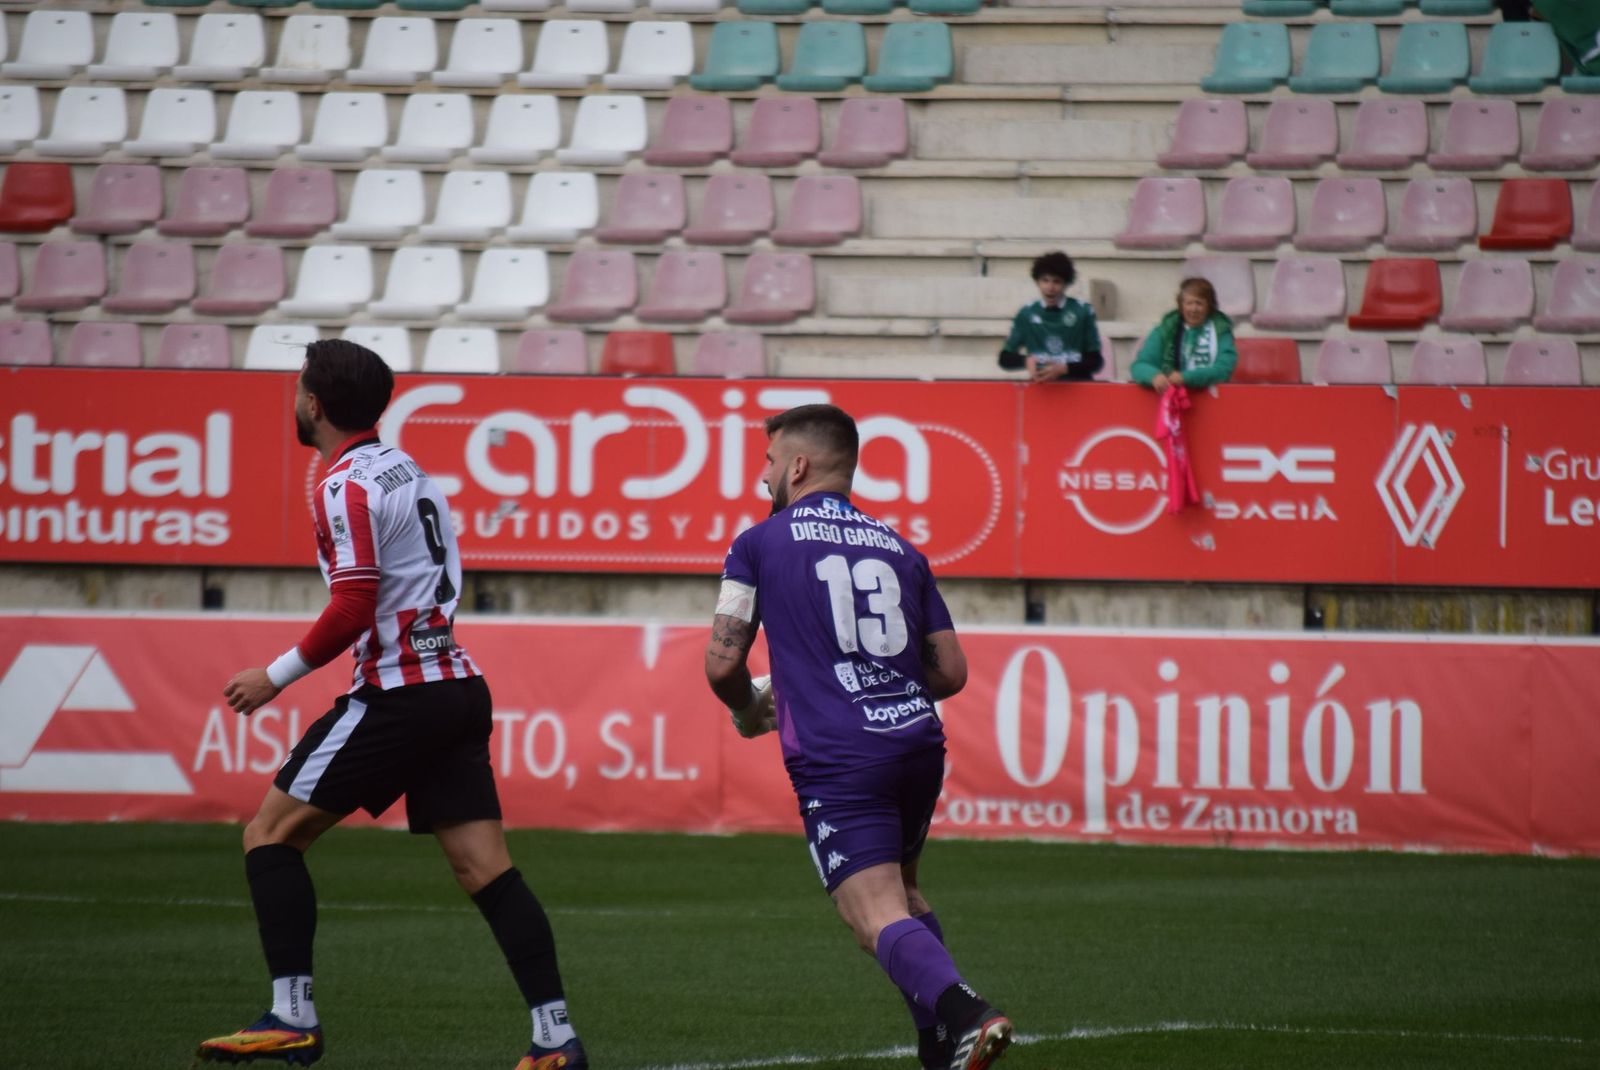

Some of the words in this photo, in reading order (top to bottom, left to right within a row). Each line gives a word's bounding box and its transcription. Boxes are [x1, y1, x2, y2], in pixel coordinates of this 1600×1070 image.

[0, 411, 232, 498] trial
[1060, 471, 1168, 491] NISSA
[0, 499, 231, 546] inturas
[450, 511, 650, 541] BUTIDOS
[669, 515, 691, 539] Y
[1214, 502, 1338, 521] DACIA
[1544, 487, 1600, 526] Le
[790, 522, 842, 545] DIEGO
[815, 554, 908, 657] 13
[598, 711, 699, 781] S.L.
[995, 645, 1427, 835] Opinión
[1116, 791, 1171, 830] de
[1181, 796, 1359, 835] Zamora
